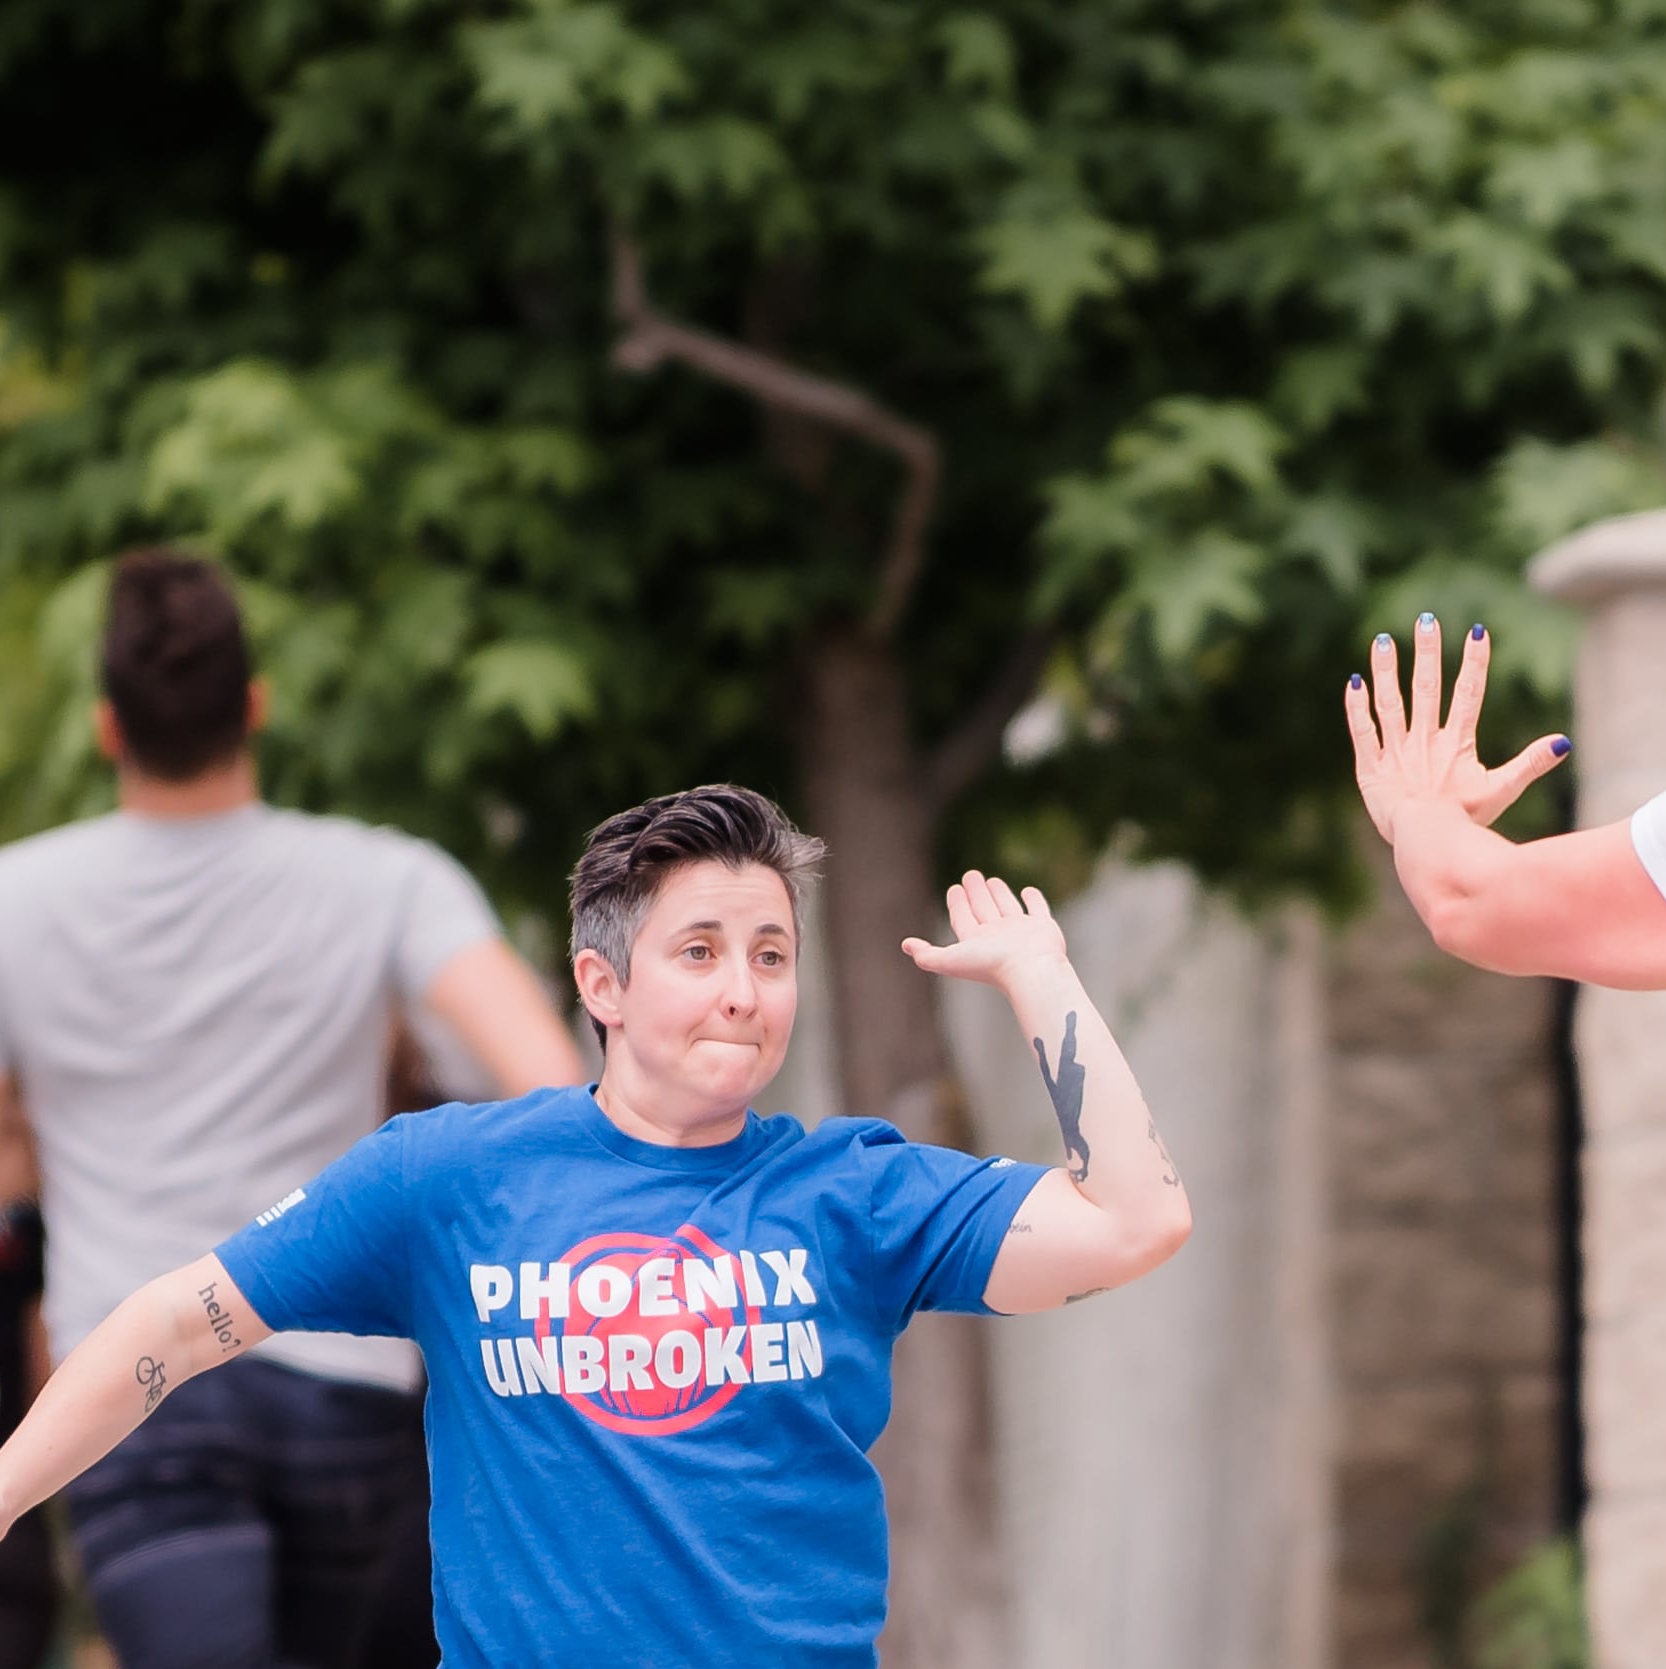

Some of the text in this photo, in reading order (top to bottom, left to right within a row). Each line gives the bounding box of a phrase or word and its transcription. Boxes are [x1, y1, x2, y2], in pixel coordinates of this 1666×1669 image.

[198, 1282, 241, 1353] hello?
[470, 1249, 817, 1323] PHOENIX
[480, 1321, 823, 1397] UNBROKEN
